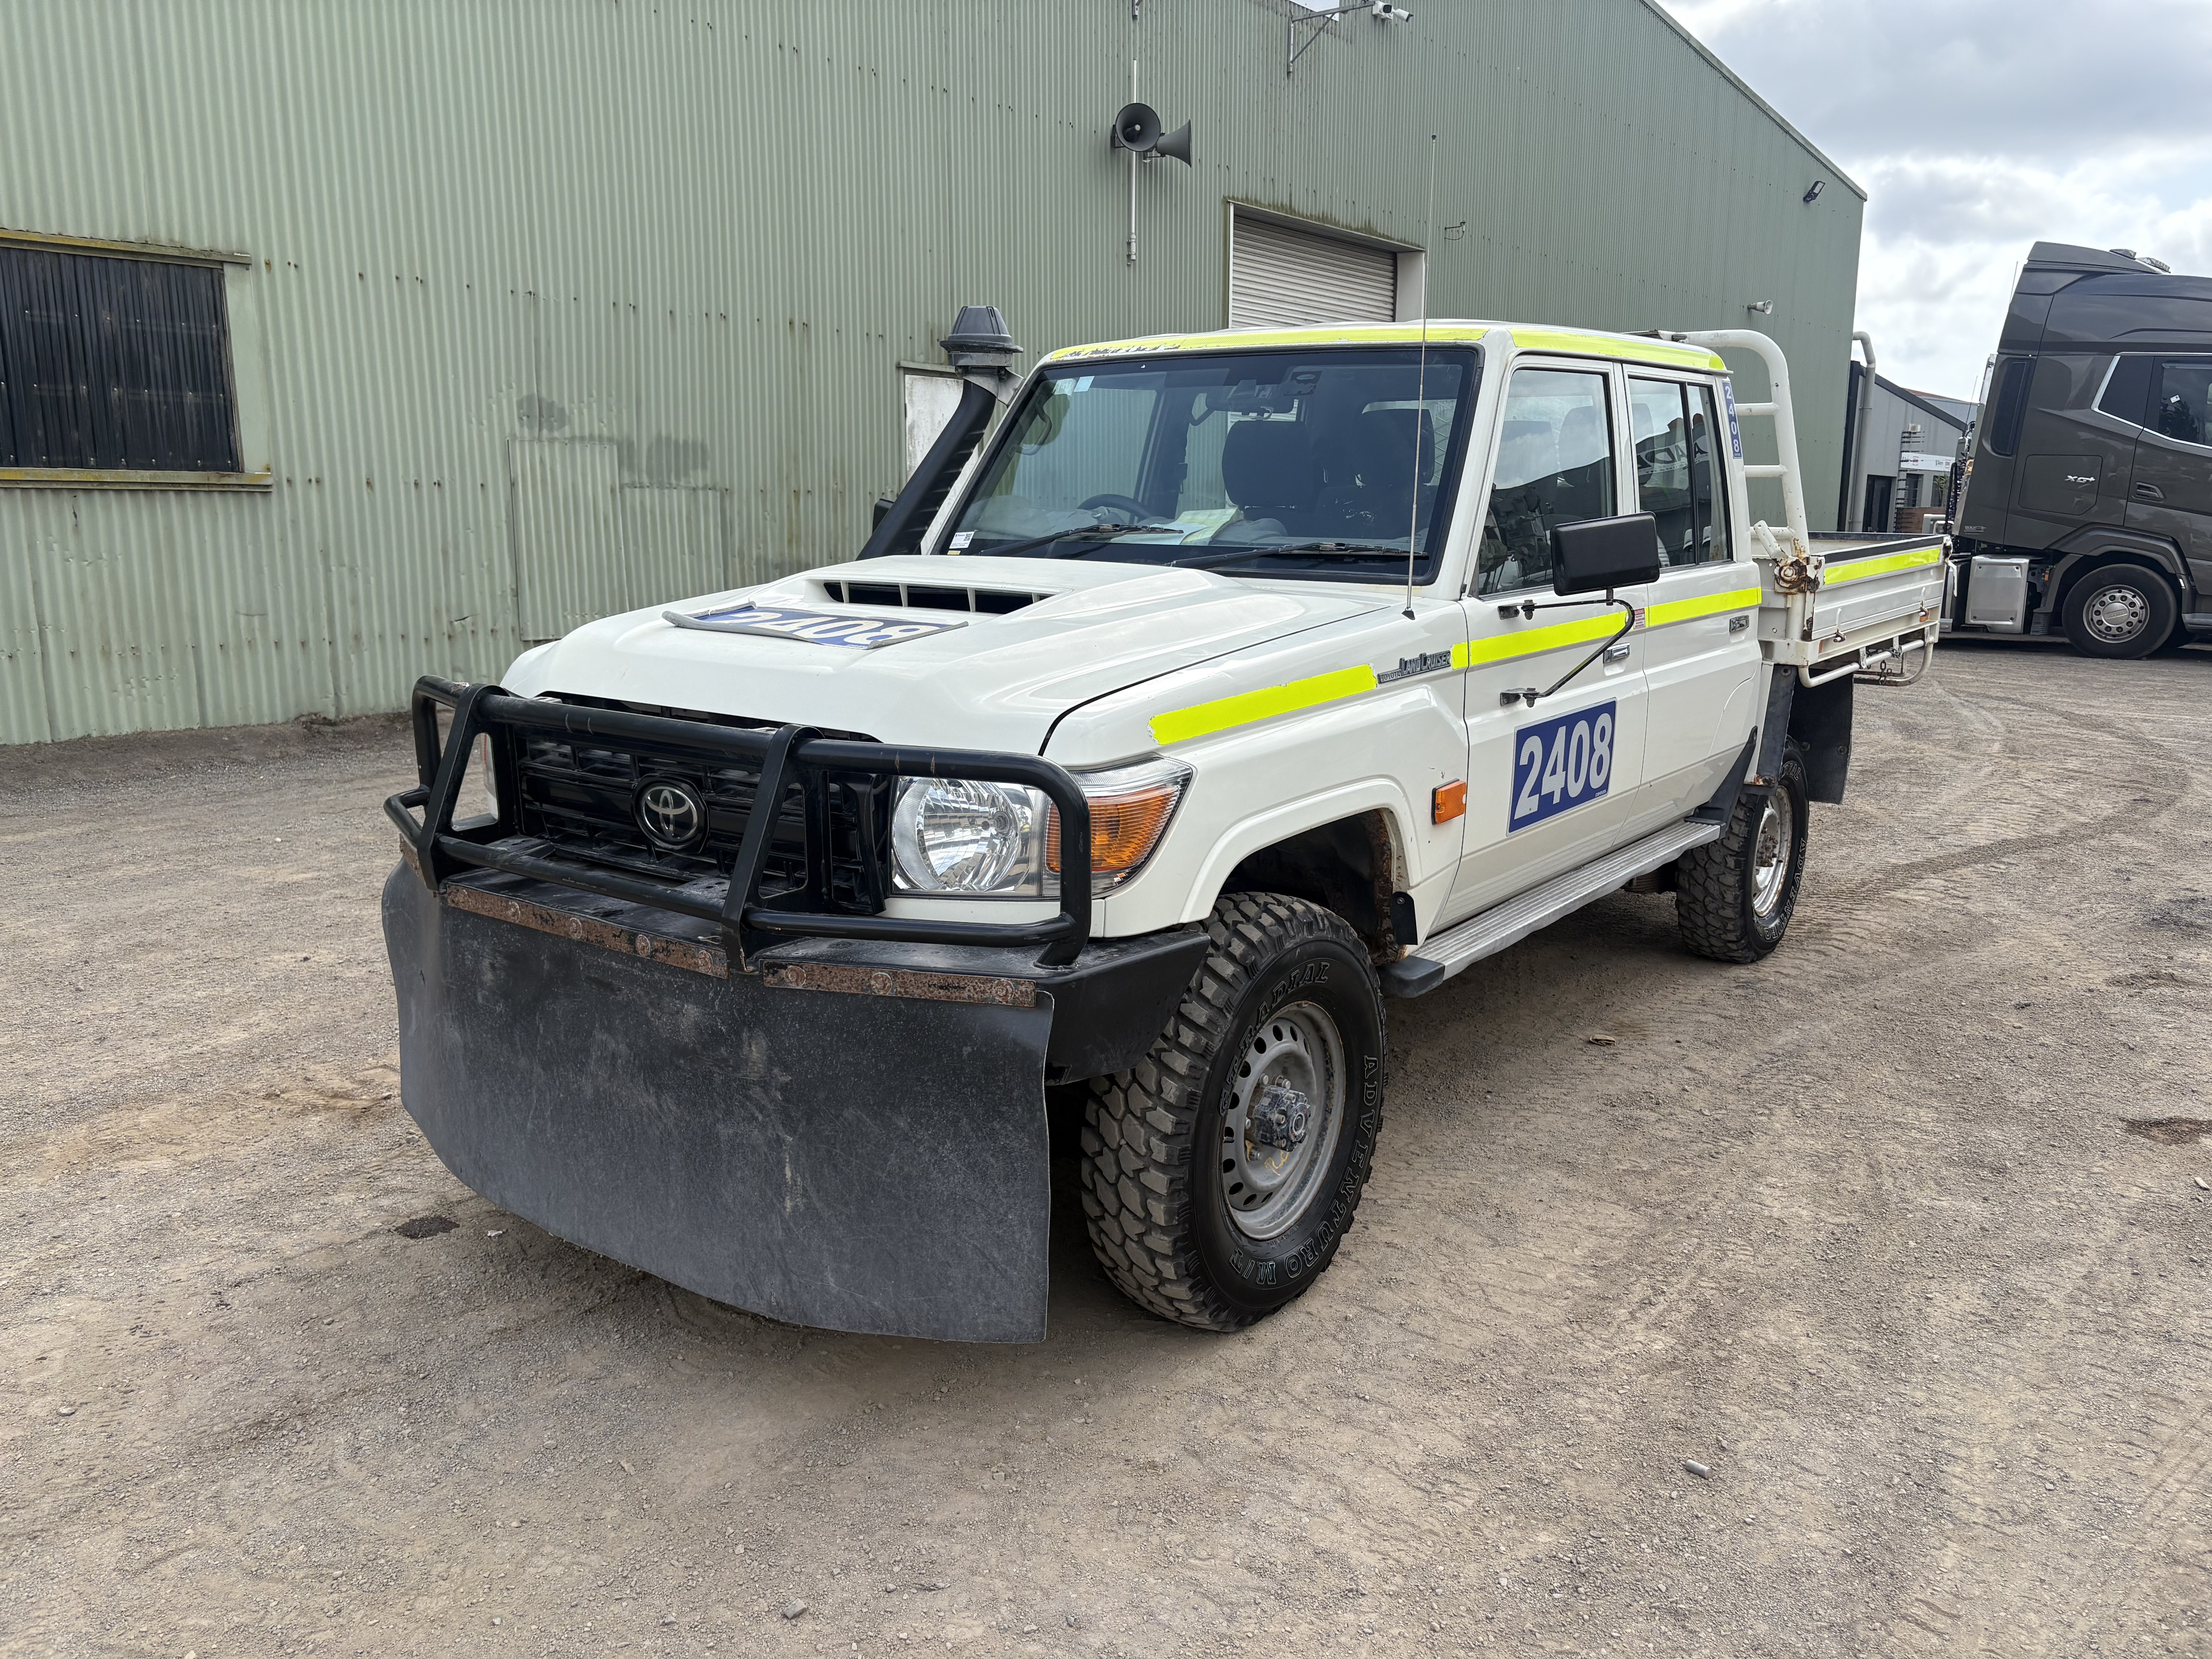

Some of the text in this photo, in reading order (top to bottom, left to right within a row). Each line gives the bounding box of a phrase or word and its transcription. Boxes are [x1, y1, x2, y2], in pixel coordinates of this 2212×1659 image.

[1725, 386, 1740, 453] 2408
[711, 612, 940, 644] 2408
[1380, 670, 1401, 682] TOYOTA
[1514, 713, 1612, 820] 2408
[1239, 962, 1330, 1056] RADIAL
[1284, 1055, 1379, 1278] ADVENTURO
[1229, 1247, 1276, 1285] M/T
